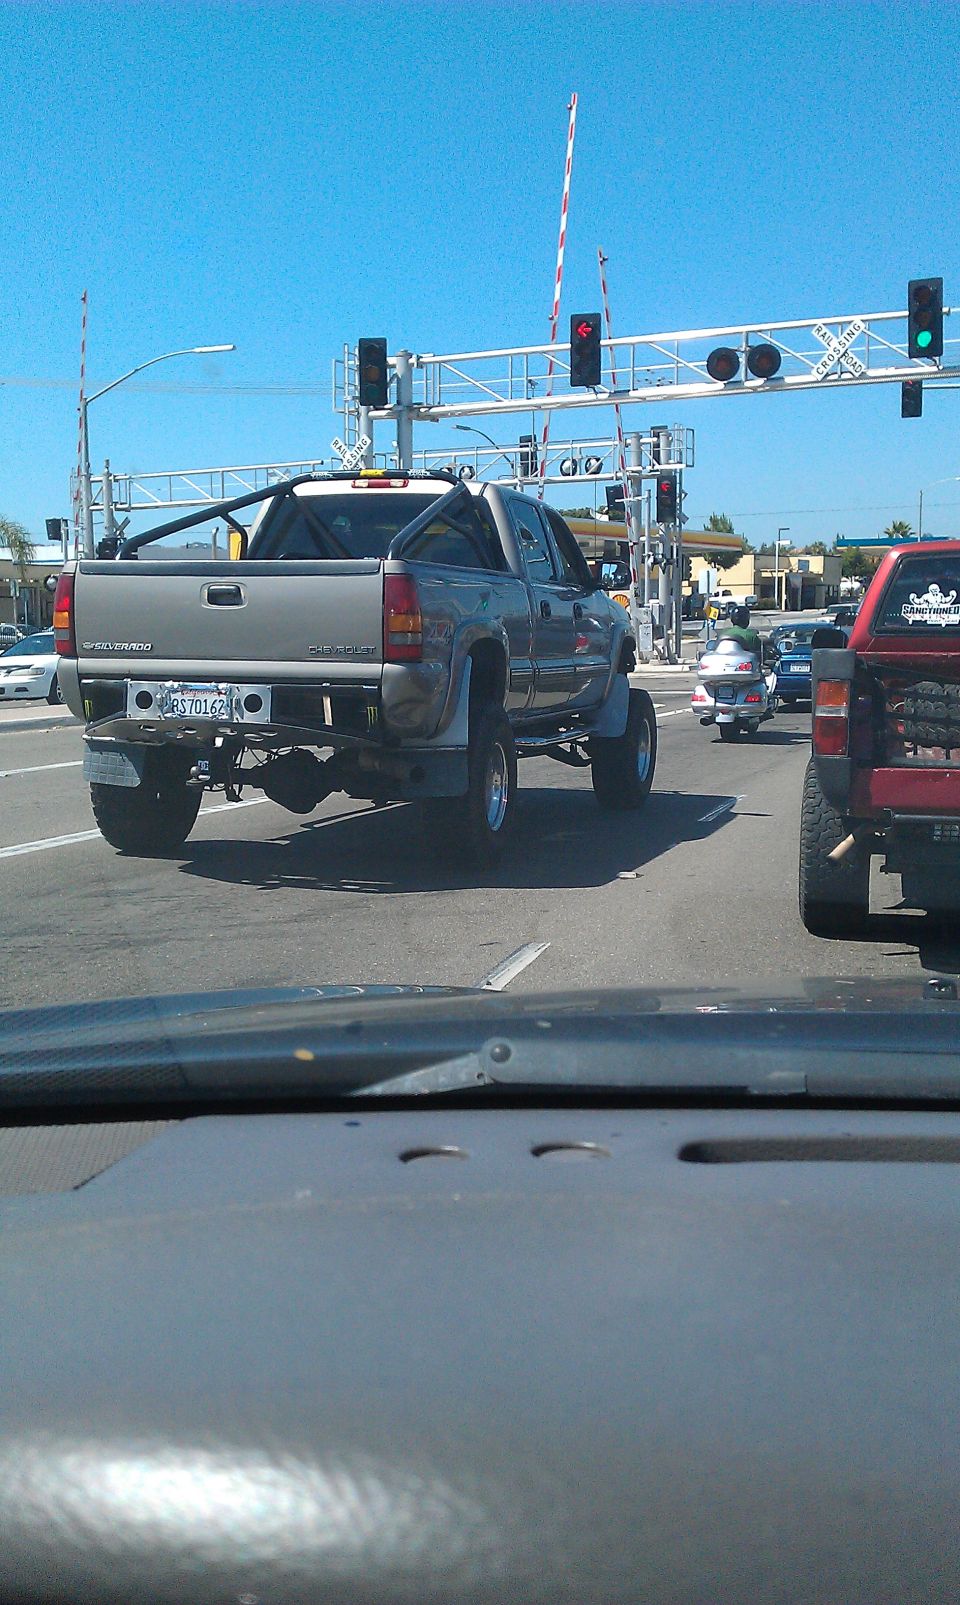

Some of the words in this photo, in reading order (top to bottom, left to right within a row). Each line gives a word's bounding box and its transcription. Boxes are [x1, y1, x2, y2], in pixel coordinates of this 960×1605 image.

[815, 325, 833, 347] RAIL
[816, 323, 861, 375] CROSSING
[843, 351, 863, 373] ROAD
[332, 439, 348, 459] RAIL
[342, 438, 367, 470] OSSING
[903, 605, 959, 615] SANCTIONED
[94, 642, 153, 651] SILVERADO
[308, 645, 376, 654] CHEVROLET
